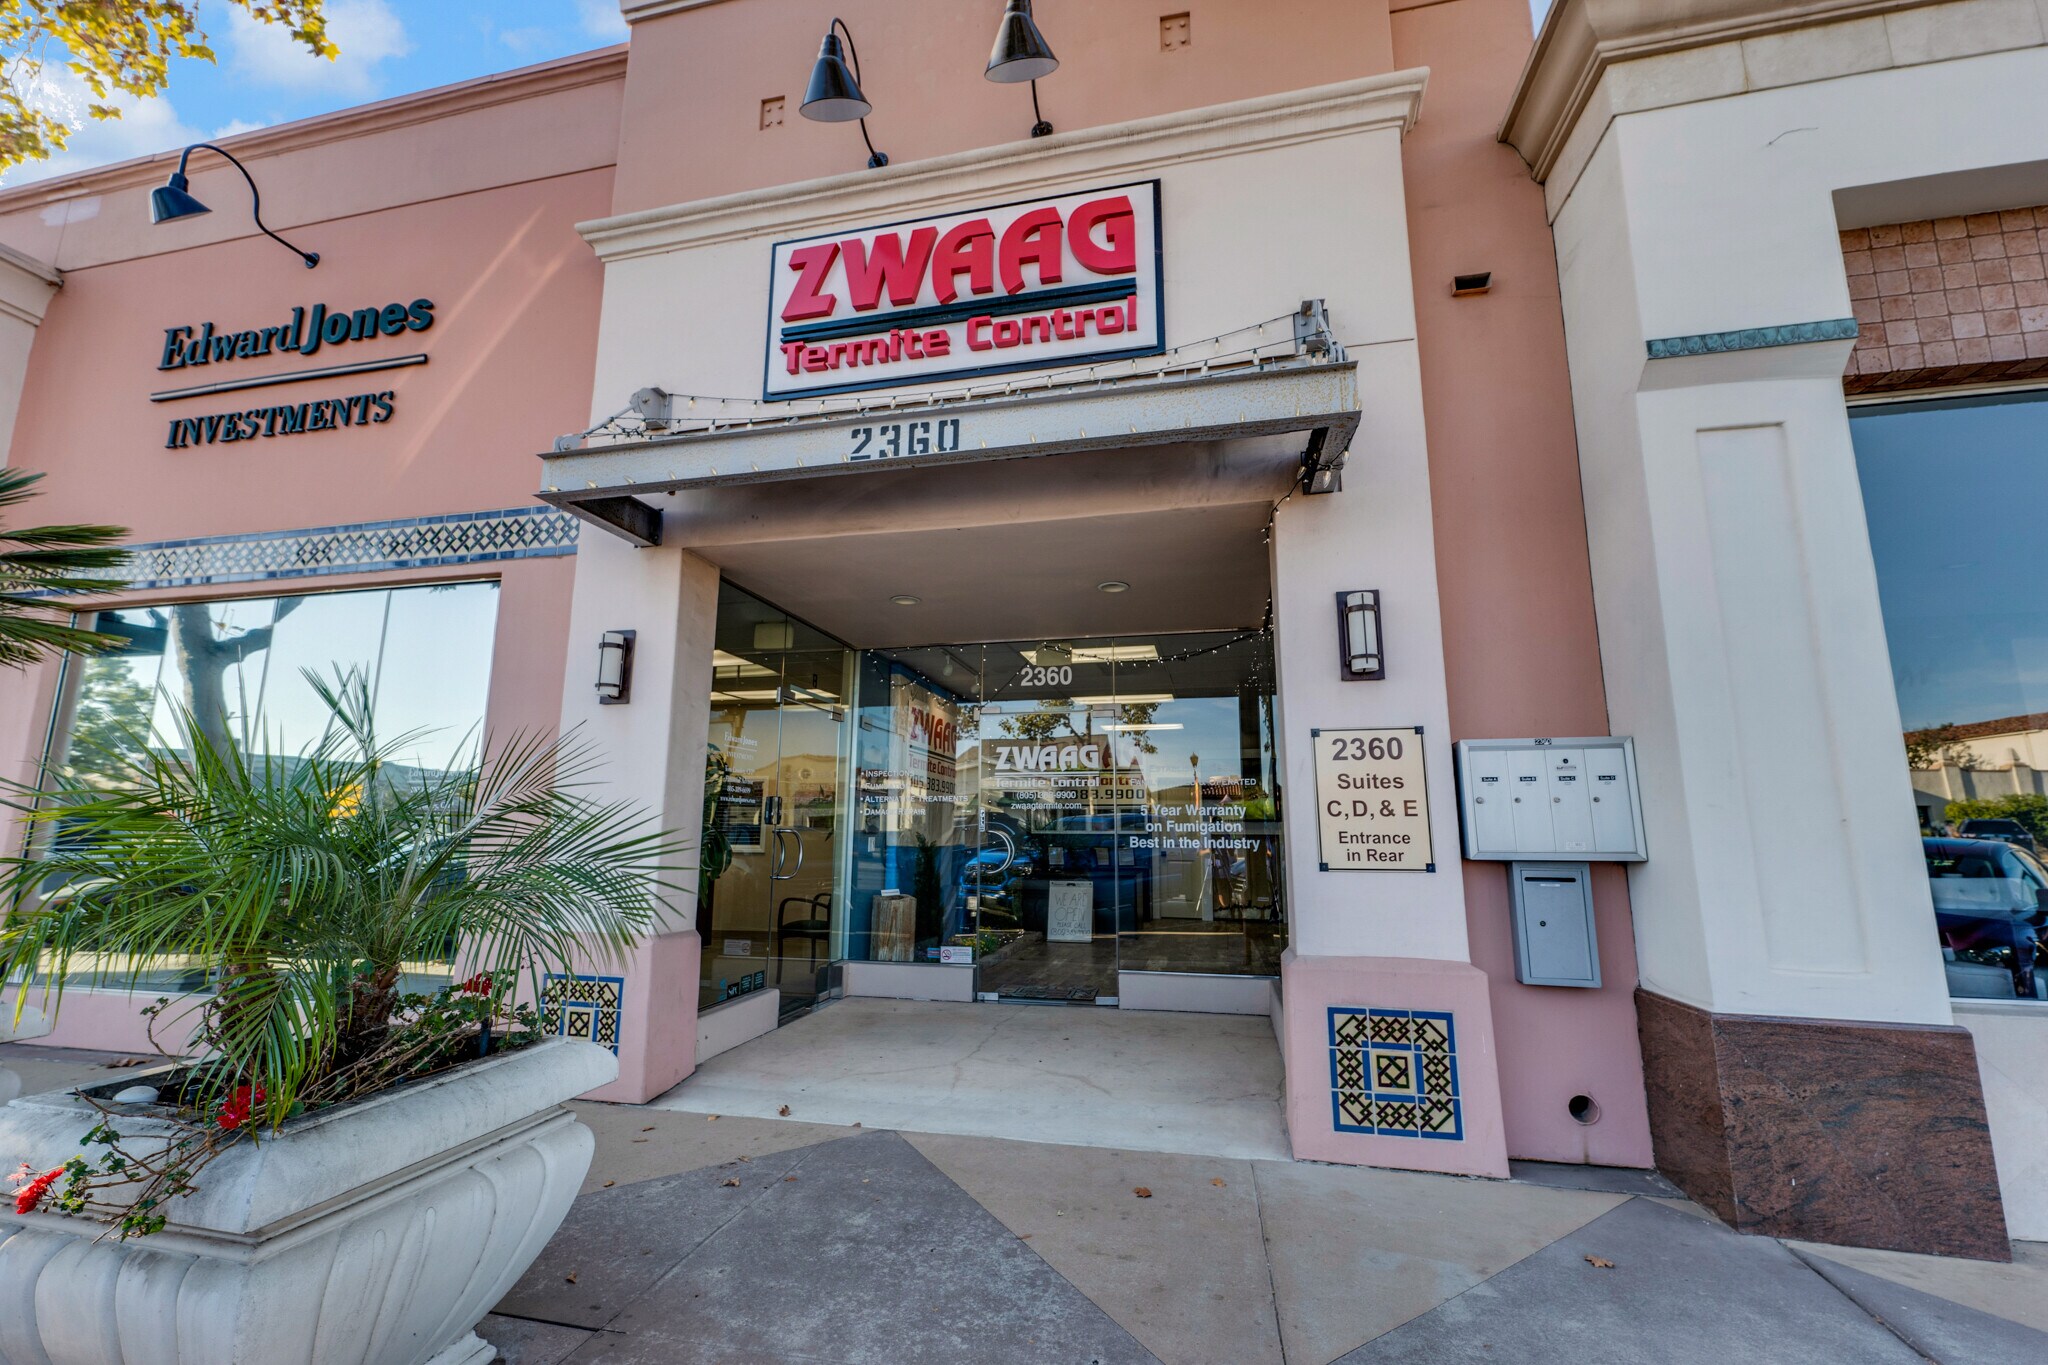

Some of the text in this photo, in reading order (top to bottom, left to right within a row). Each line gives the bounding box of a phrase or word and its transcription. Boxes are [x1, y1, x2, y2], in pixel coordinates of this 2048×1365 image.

[780, 194, 1137, 322] ZWAAG
[781, 296, 1138, 375] Termite Control
[165, 390, 394, 449] INVESTMENTS
[850, 418, 960, 463] 2360
[1020, 665, 1073, 687] 2360
[1332, 736, 1404, 761] 2360
[995, 744, 1100, 772] ZWAAG
[937, 761, 957, 780] Contro
[996, 776, 1100, 788] Termite Control
[1337, 773, 1405, 790] Suites
[919, 795, 969, 803] TREATMENTS
[1010, 802, 1082, 811] zwaagtermite.com
[1140, 804, 1247, 819] 5 Year Warranty
[1404, 799, 1419, 817] E
[1145, 820, 1242, 835] on Fumigation
[1129, 836, 1260, 852] Best in the Industry
[1338, 831, 1411, 845] Entrance
[1347, 848, 1405, 862] in Rear
[1054, 892, 1068, 907] WE
[1054, 906, 1086, 921] OPEN
